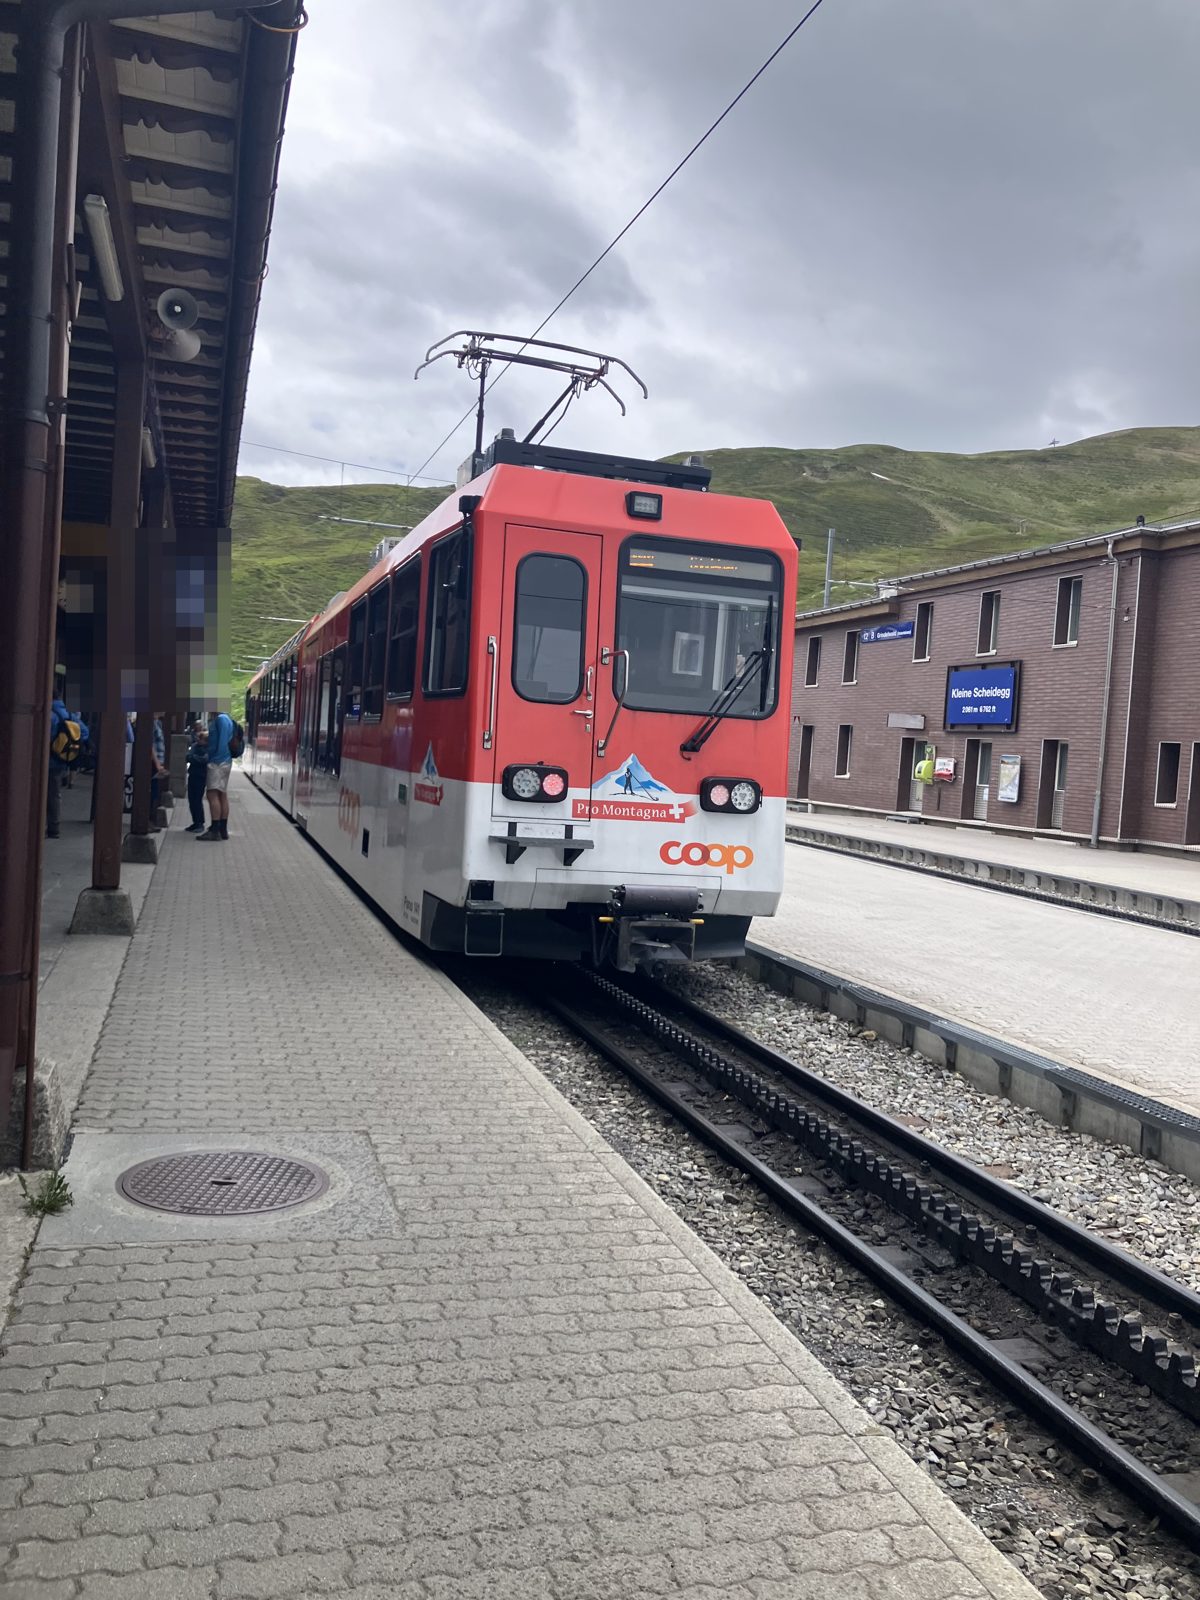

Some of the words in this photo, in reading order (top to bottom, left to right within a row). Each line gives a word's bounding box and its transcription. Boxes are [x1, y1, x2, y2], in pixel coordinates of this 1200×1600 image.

[951, 688, 972, 699] Kleine
[973, 687, 1010, 699] Scheidegg
[577, 803, 599, 815] Pro
[602, 804, 667, 820] Montagna
[660, 841, 754, 874] coop
